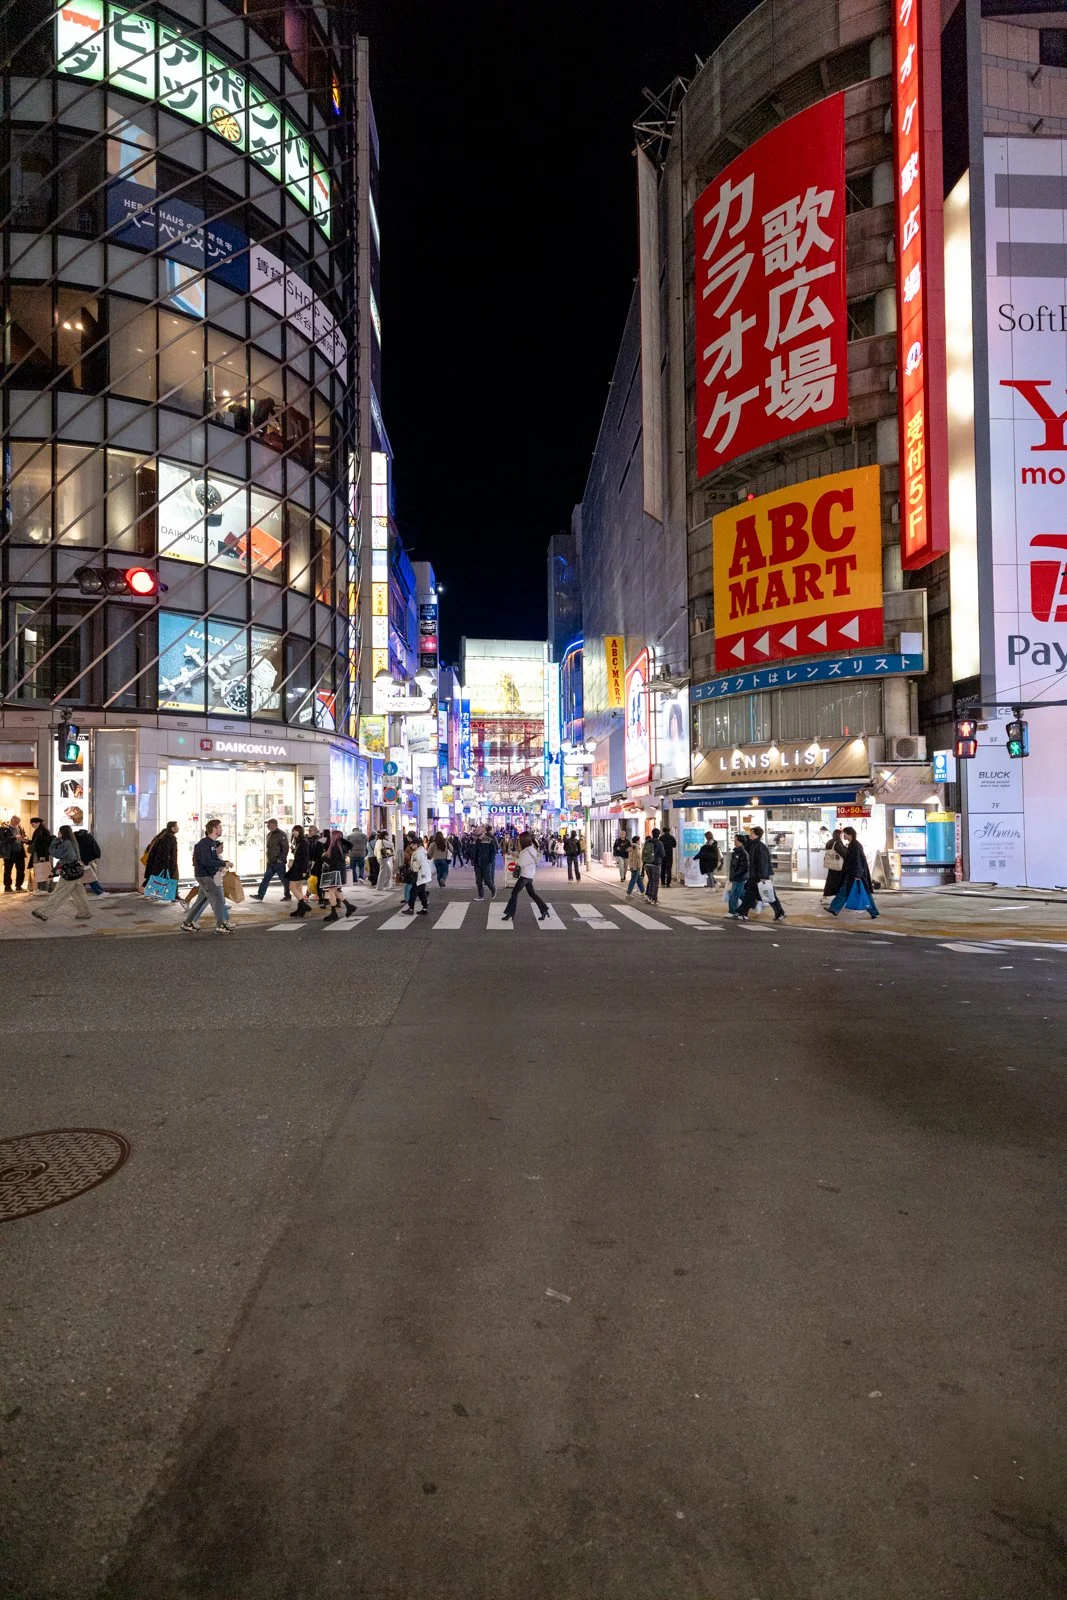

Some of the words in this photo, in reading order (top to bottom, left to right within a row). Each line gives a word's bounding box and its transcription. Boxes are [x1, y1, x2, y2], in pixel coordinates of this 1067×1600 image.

[62, 42, 199, 110] ダーツ
[159, 210, 184, 227] HAUS
[702, 172, 760, 454] カラオケ
[762, 186, 837, 421] 歌広場
[160, 525, 216, 548] DAIKOKUA
[728, 487, 857, 579] ABC
[728, 554, 857, 621] MART
[189, 629, 229, 648] HARRY
[695, 656, 911, 698] コンタクトはレンズリスト
[215, 741, 287, 756] DAIKOKUYA
[720, 755, 771, 771] LENS
[978, 771, 1011, 779] BLUCK
